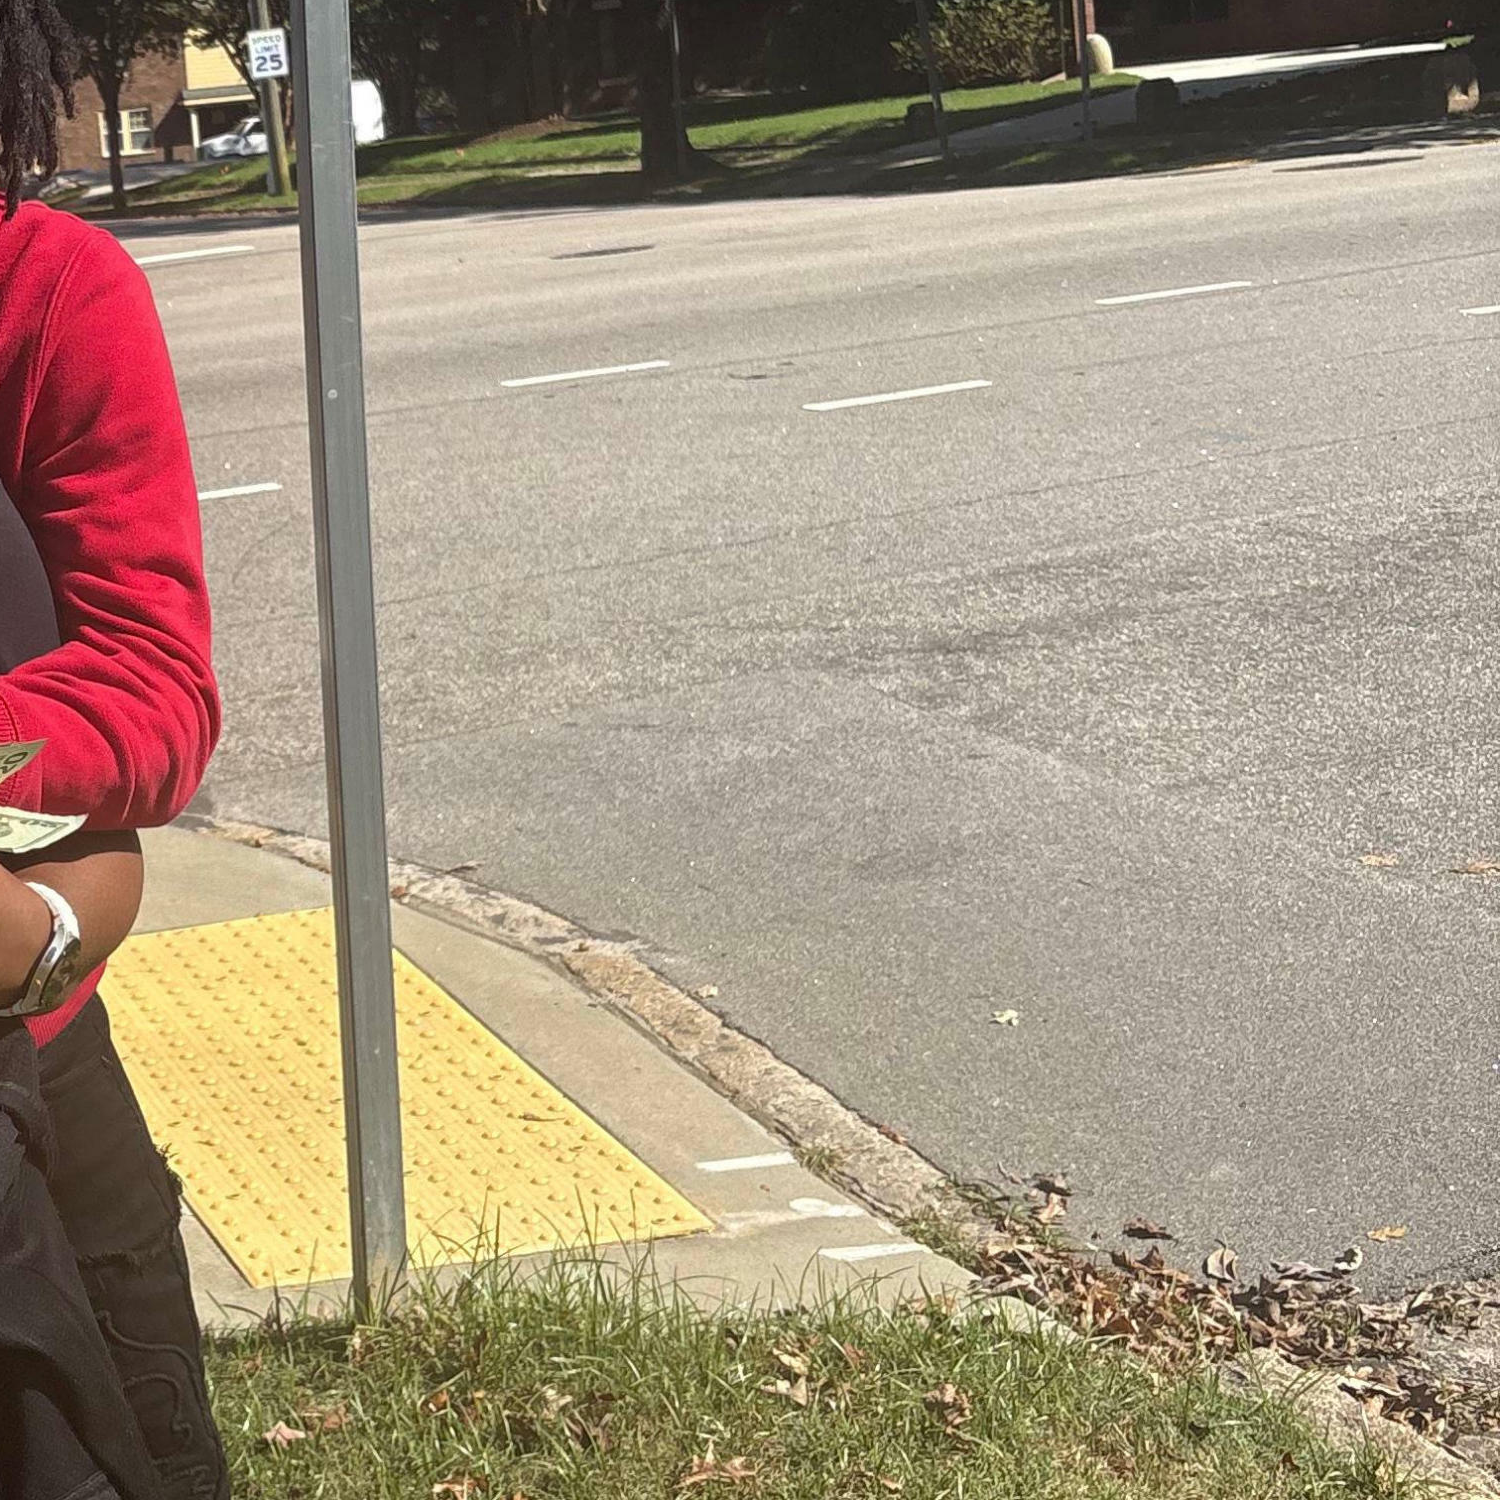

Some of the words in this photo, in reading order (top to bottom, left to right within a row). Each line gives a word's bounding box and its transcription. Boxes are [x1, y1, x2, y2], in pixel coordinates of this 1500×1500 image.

[252, 35, 282, 45] SPEED
[255, 44, 280, 54] LIMIT
[255, 54, 283, 72] 25
